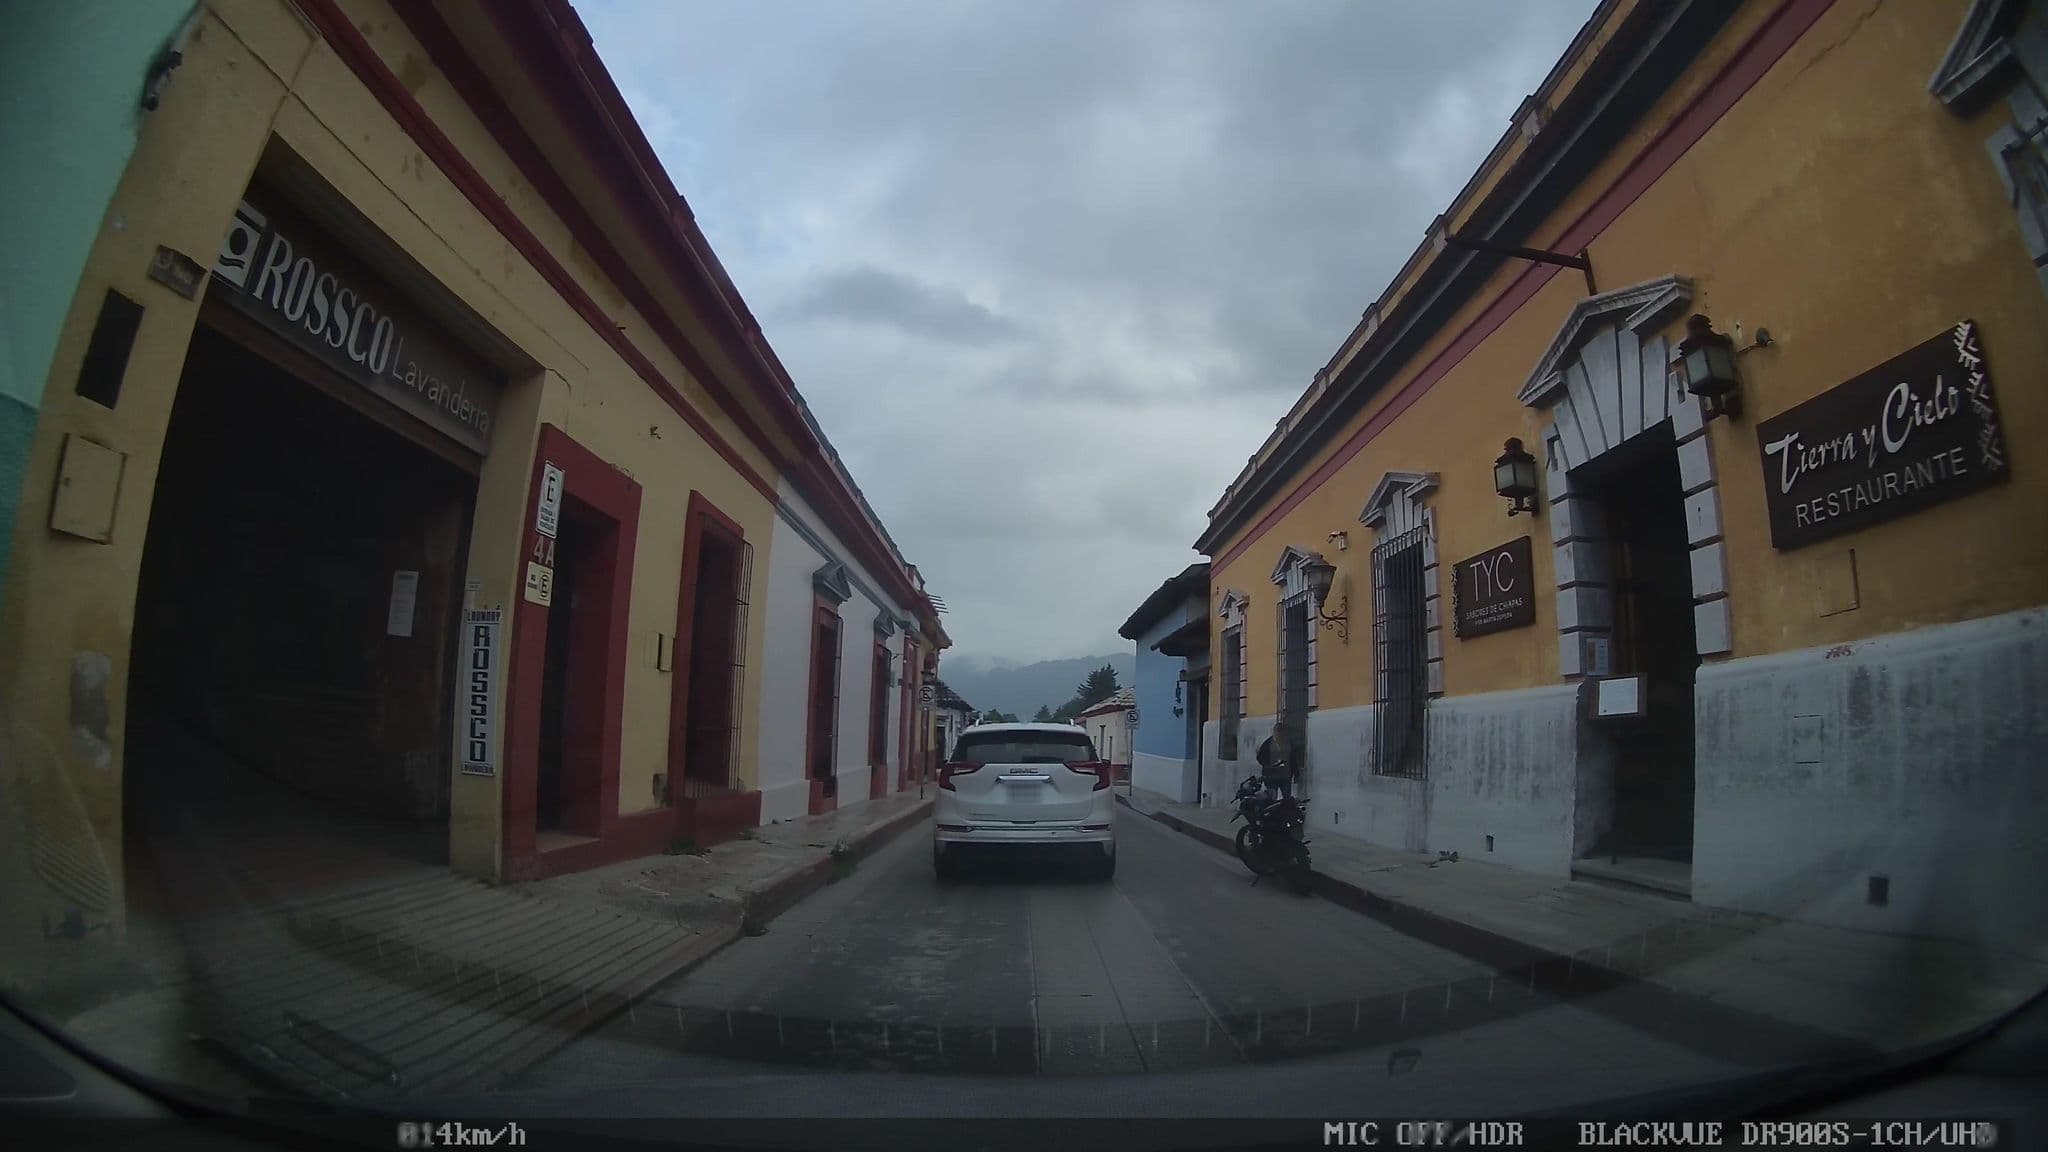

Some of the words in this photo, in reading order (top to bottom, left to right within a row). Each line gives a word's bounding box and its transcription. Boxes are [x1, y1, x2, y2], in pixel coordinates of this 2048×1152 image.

[253, 232, 394, 375] ROSSCO
[1765, 431, 1858, 494] Tierra
[1862, 424, 1876, 469] y
[1882, 374, 1959, 453] Cielo
[1796, 446, 1968, 528] RESTAURANTE
[1469, 551, 1514, 601] TYC
